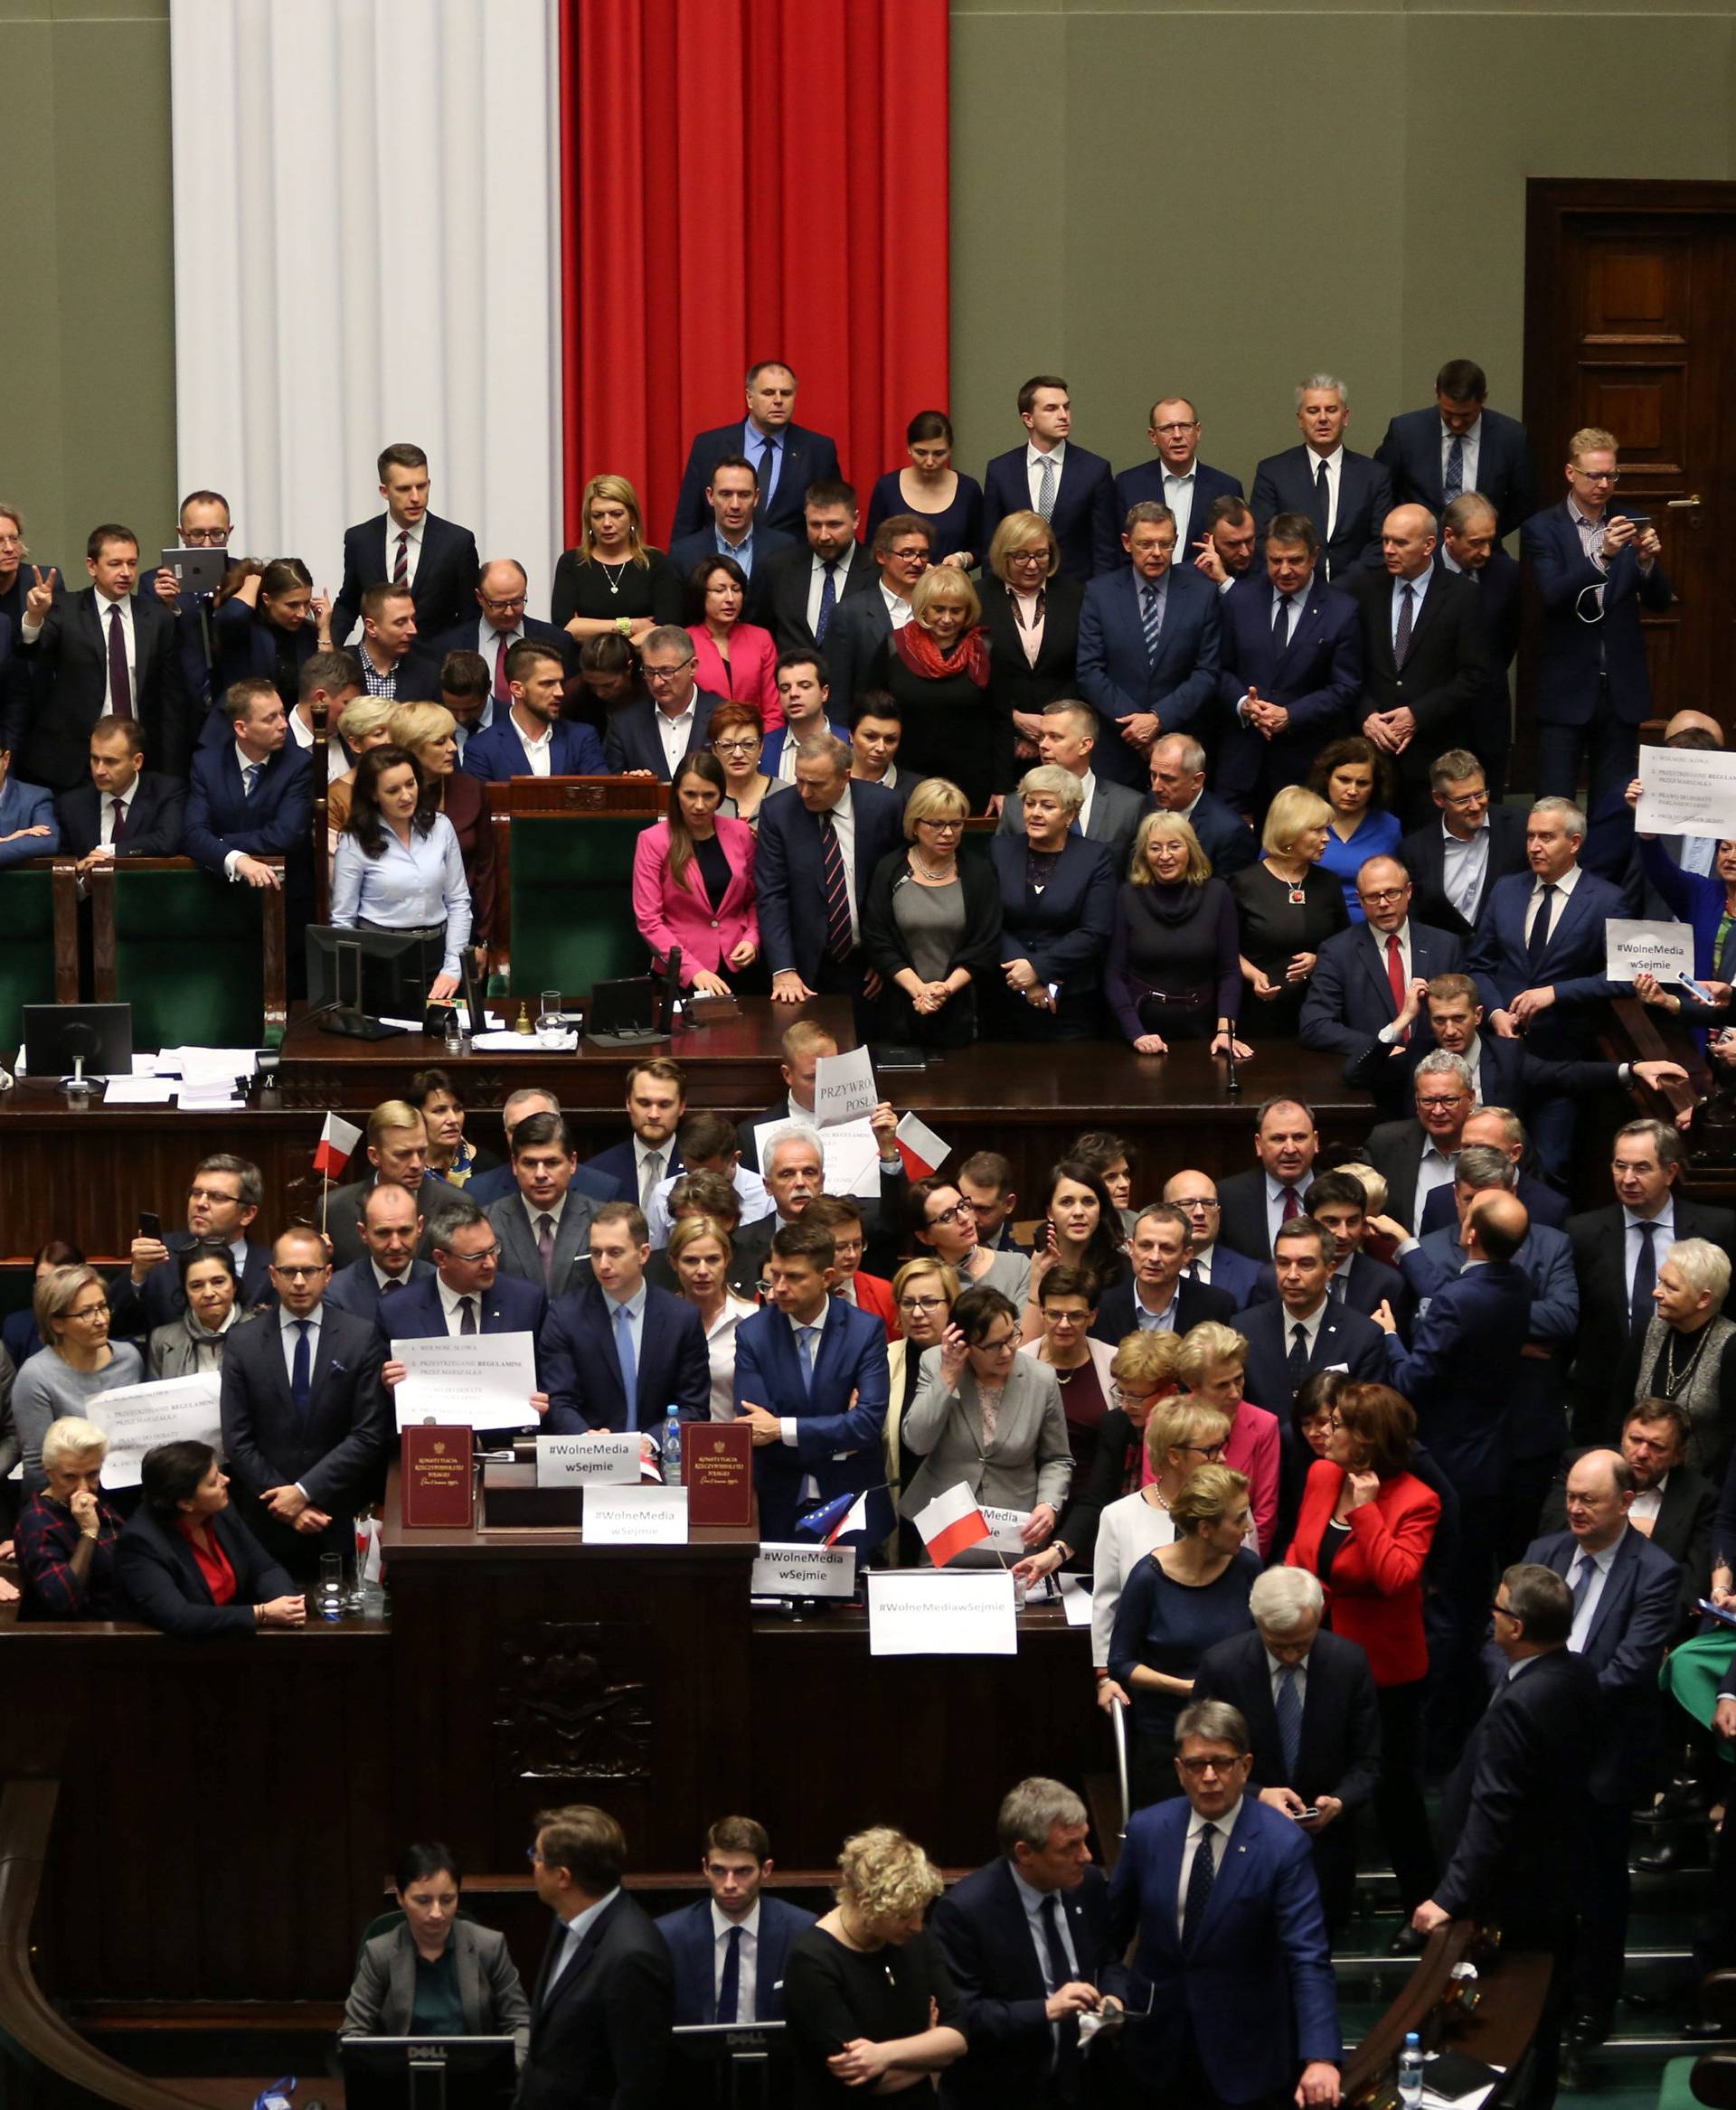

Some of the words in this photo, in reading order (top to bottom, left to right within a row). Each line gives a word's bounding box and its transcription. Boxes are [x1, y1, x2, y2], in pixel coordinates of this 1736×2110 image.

[1617, 944, 1684, 956] #WolneMedia
[1630, 960, 1671, 970] wSejmie
[549, 1444, 629, 1455] #WolneMedia
[565, 1462, 614, 1473] wSejmie
[595, 1511, 675, 1521] #WolneMedia
[611, 1526, 658, 1537] wSejmie
[764, 1552, 844, 1564] #WolneMedia
[779, 1569, 827, 1581] wSejmie
[879, 1601, 1005, 1613] #WolneMediawSejmie
[408, 2045, 448, 2059] DELL
